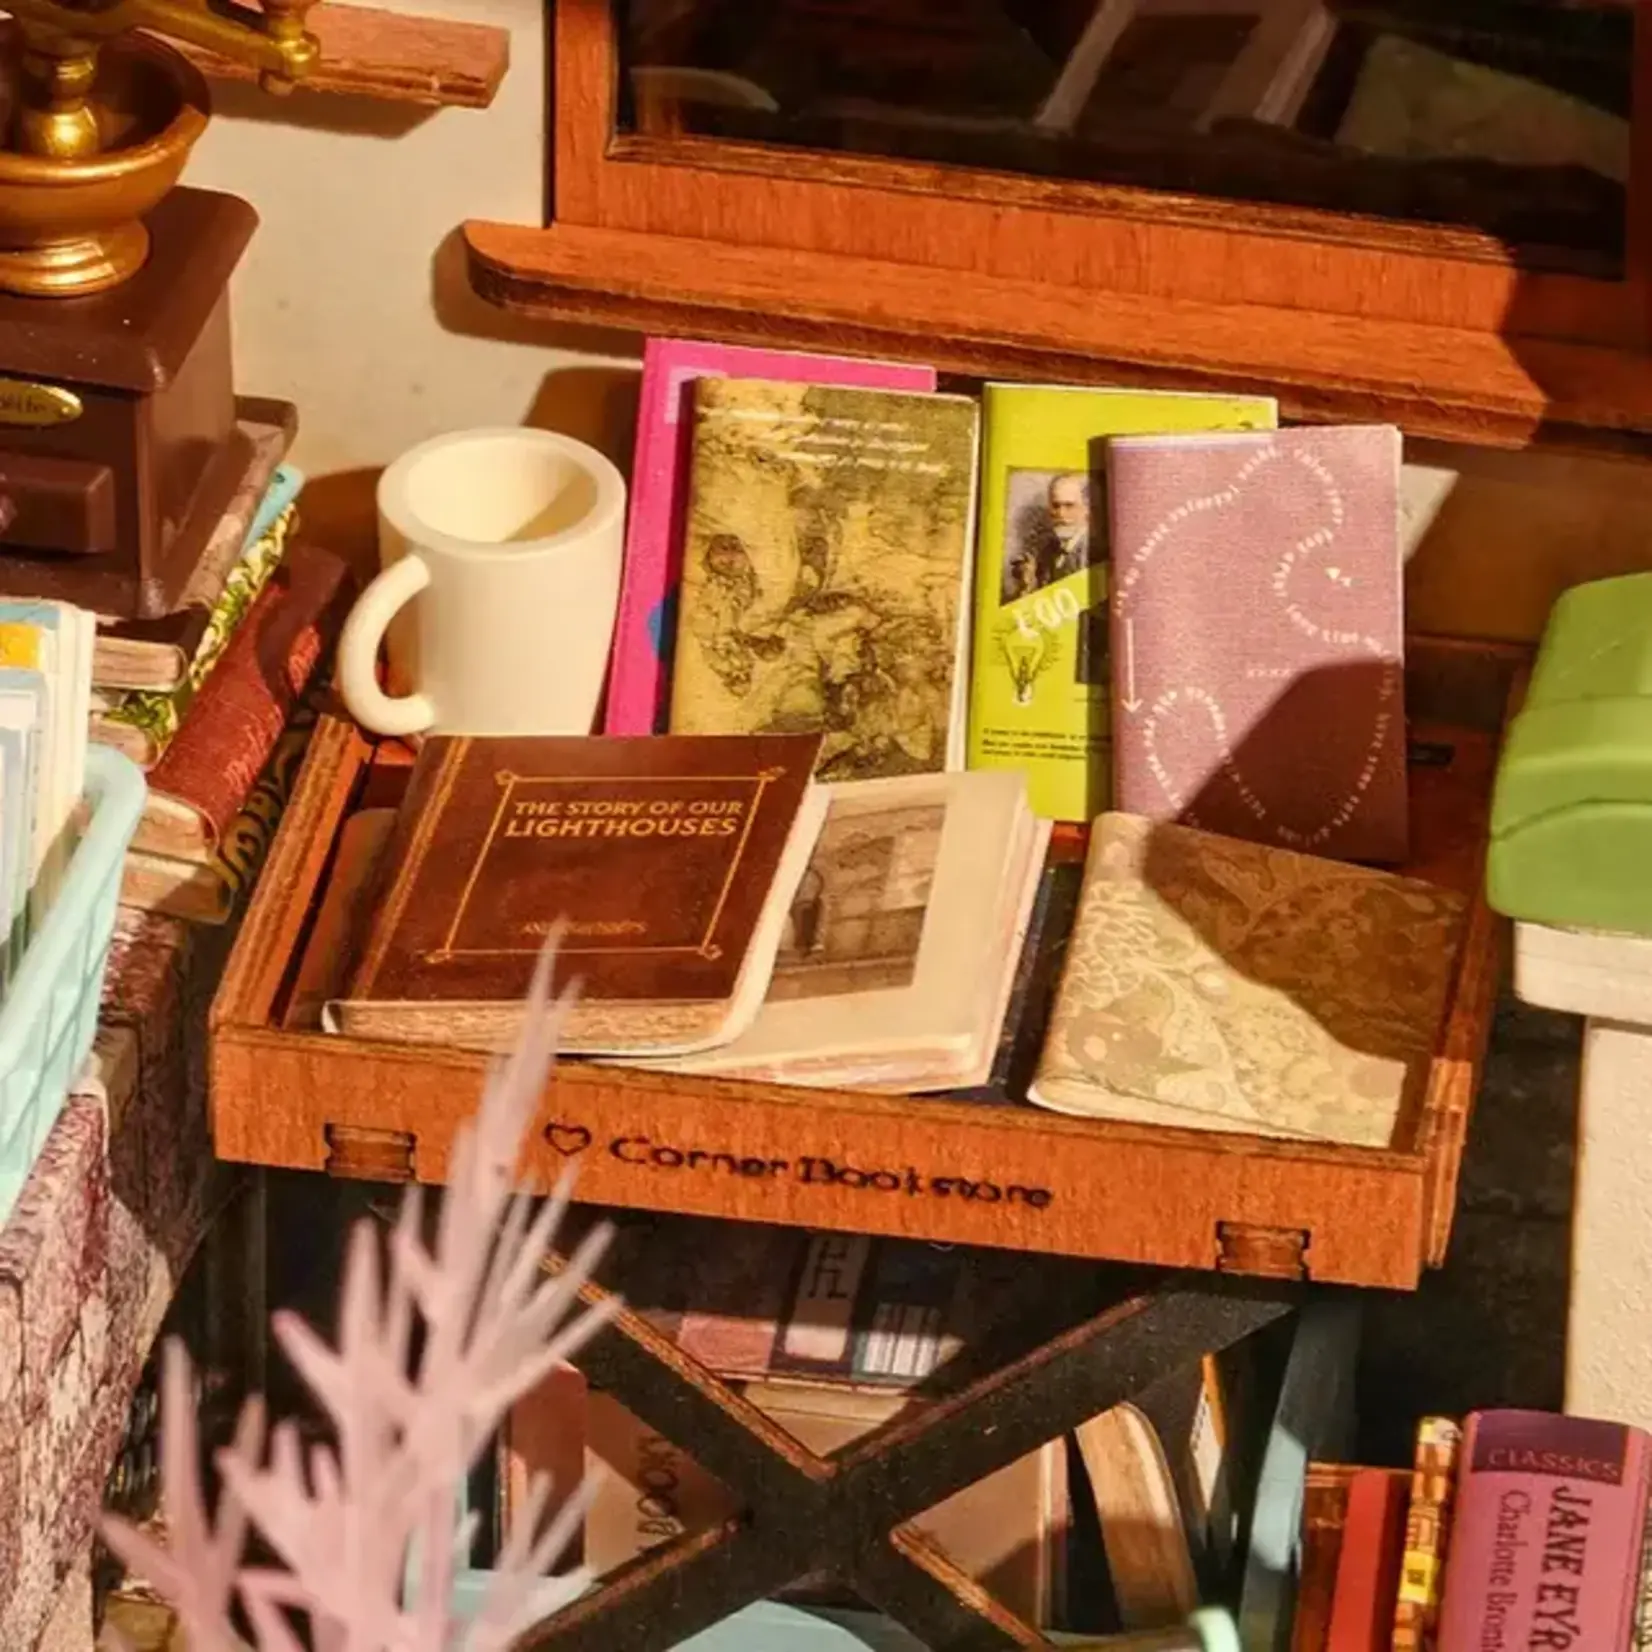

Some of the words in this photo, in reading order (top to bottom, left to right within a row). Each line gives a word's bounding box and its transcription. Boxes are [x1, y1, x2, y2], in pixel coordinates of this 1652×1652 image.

[505, 818, 738, 838] LIGHTHOUSES
[515, 801, 563, 816] THE
[566, 801, 645, 816] STORY
[650, 801, 683, 816] OF
[688, 801, 744, 816] OUR
[609, 1136, 788, 1178] Corner
[1487, 1449, 1619, 1478] CLASSICS
[1489, 1490, 1531, 1586] Charlotte
[1542, 1486, 1592, 1577] JANE
[1529, 1584, 1581, 1652] EYR
